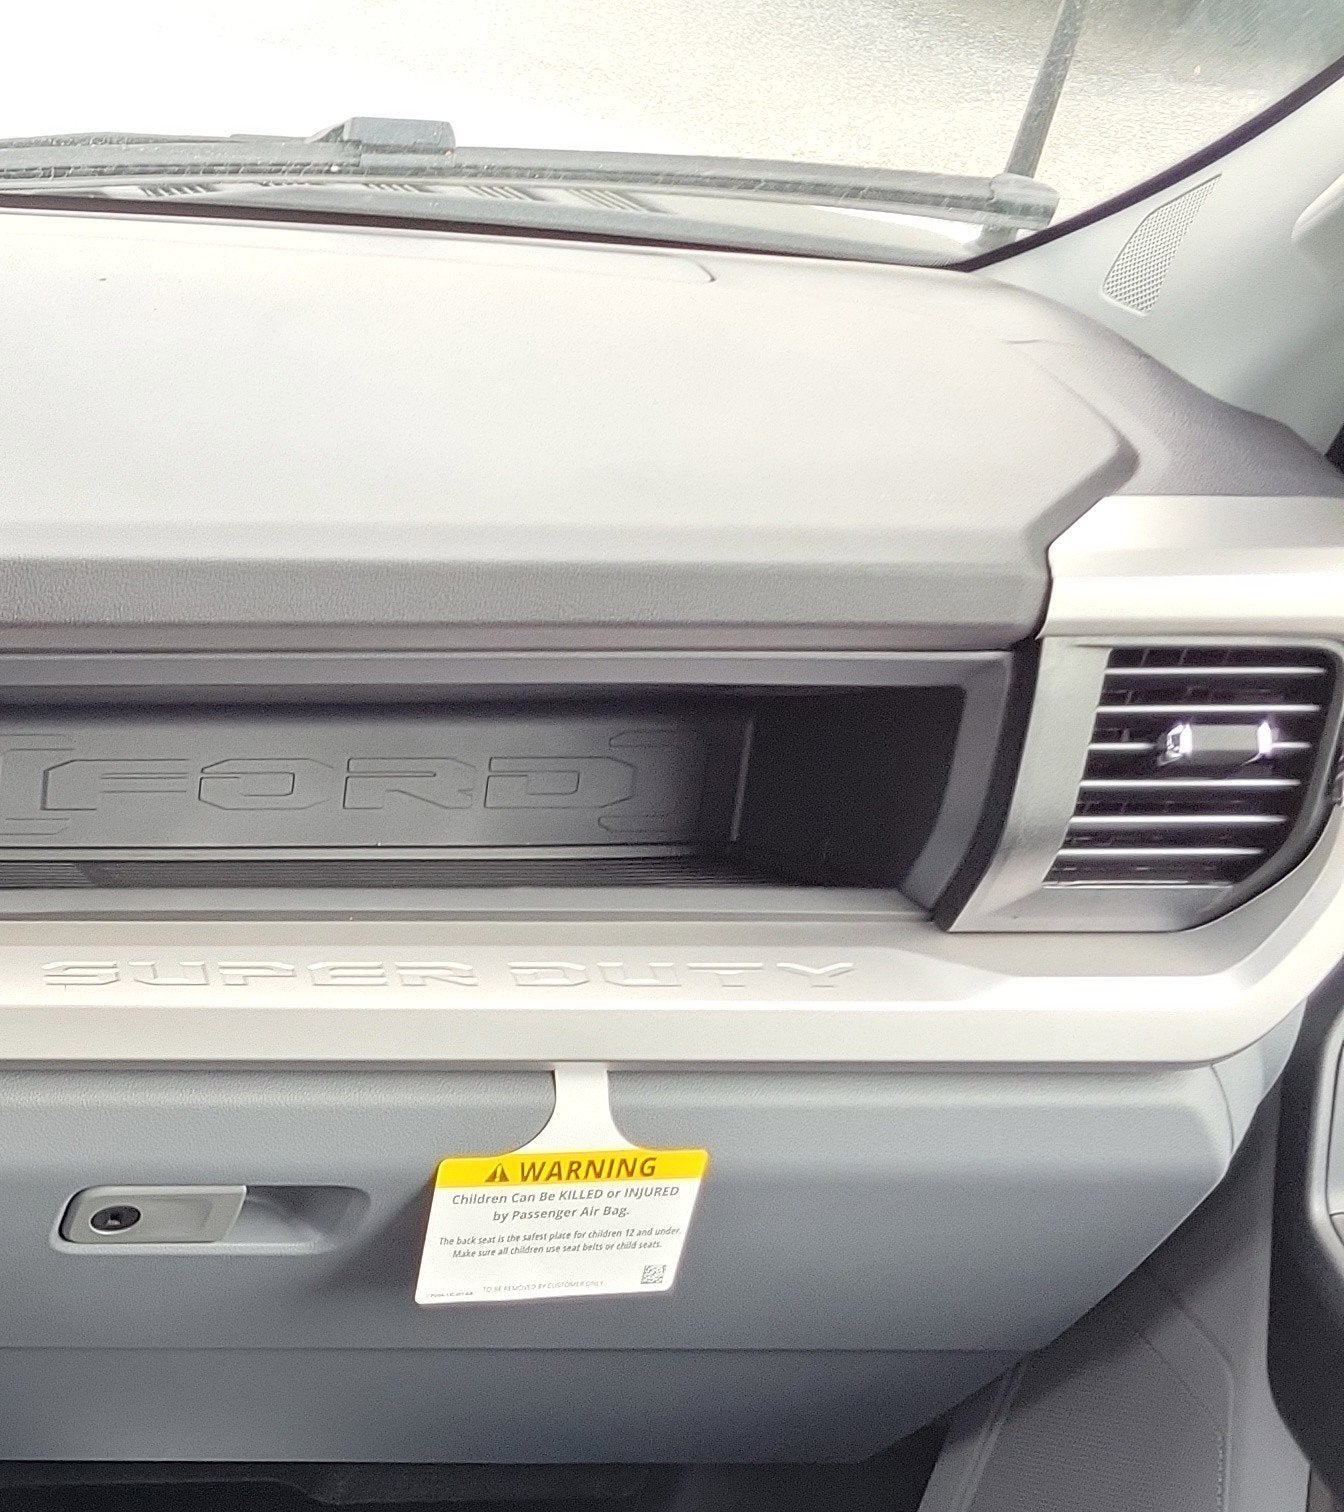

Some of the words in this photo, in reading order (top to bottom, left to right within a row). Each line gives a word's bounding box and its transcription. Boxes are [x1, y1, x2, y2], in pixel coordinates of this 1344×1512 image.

[42, 756, 638, 811] FORD
[42, 958, 480, 989] SUPER
[512, 960, 855, 989] DUTY
[520, 1157, 657, 1182] WARNING
[452, 1193, 507, 1205] Children
[512, 1192, 535, 1203] Can
[539, 1192, 555, 1201] Be
[559, 1189, 603, 1200] KILLED
[607, 1190, 620, 1198] or
[624, 1186, 679, 1199] INJURED
[493, 1211, 508, 1223] by
[512, 1208, 577, 1220] Passenger
[580, 1207, 599, 1217] Air
[603, 1206, 629, 1218] Bag.
[439, 1237, 454, 1245] The
[456, 1235, 476, 1245] back
[478, 1236, 495, 1244] seat
[507, 1234, 519, 1243] the
[522, 1232, 547, 1242] safest
[549, 1231, 571, 1242] place
[573, 1230, 586, 1239] for
[588, 1229, 622, 1238] children
[625, 1228, 634, 1237] 12
[636, 1227, 653, 1236] and
[452, 1249, 475, 1258] Make
[478, 1249, 495, 1257] sure
[498, 1247, 508, 1256] all
[510, 1245, 543, 1255] children
[545, 1245, 560, 1253] use
[563, 1244, 581, 1252] seat
[583, 1242, 603, 1251] belts
[617, 1240, 637, 1250] child
[639, 1241, 662, 1249] seats.
